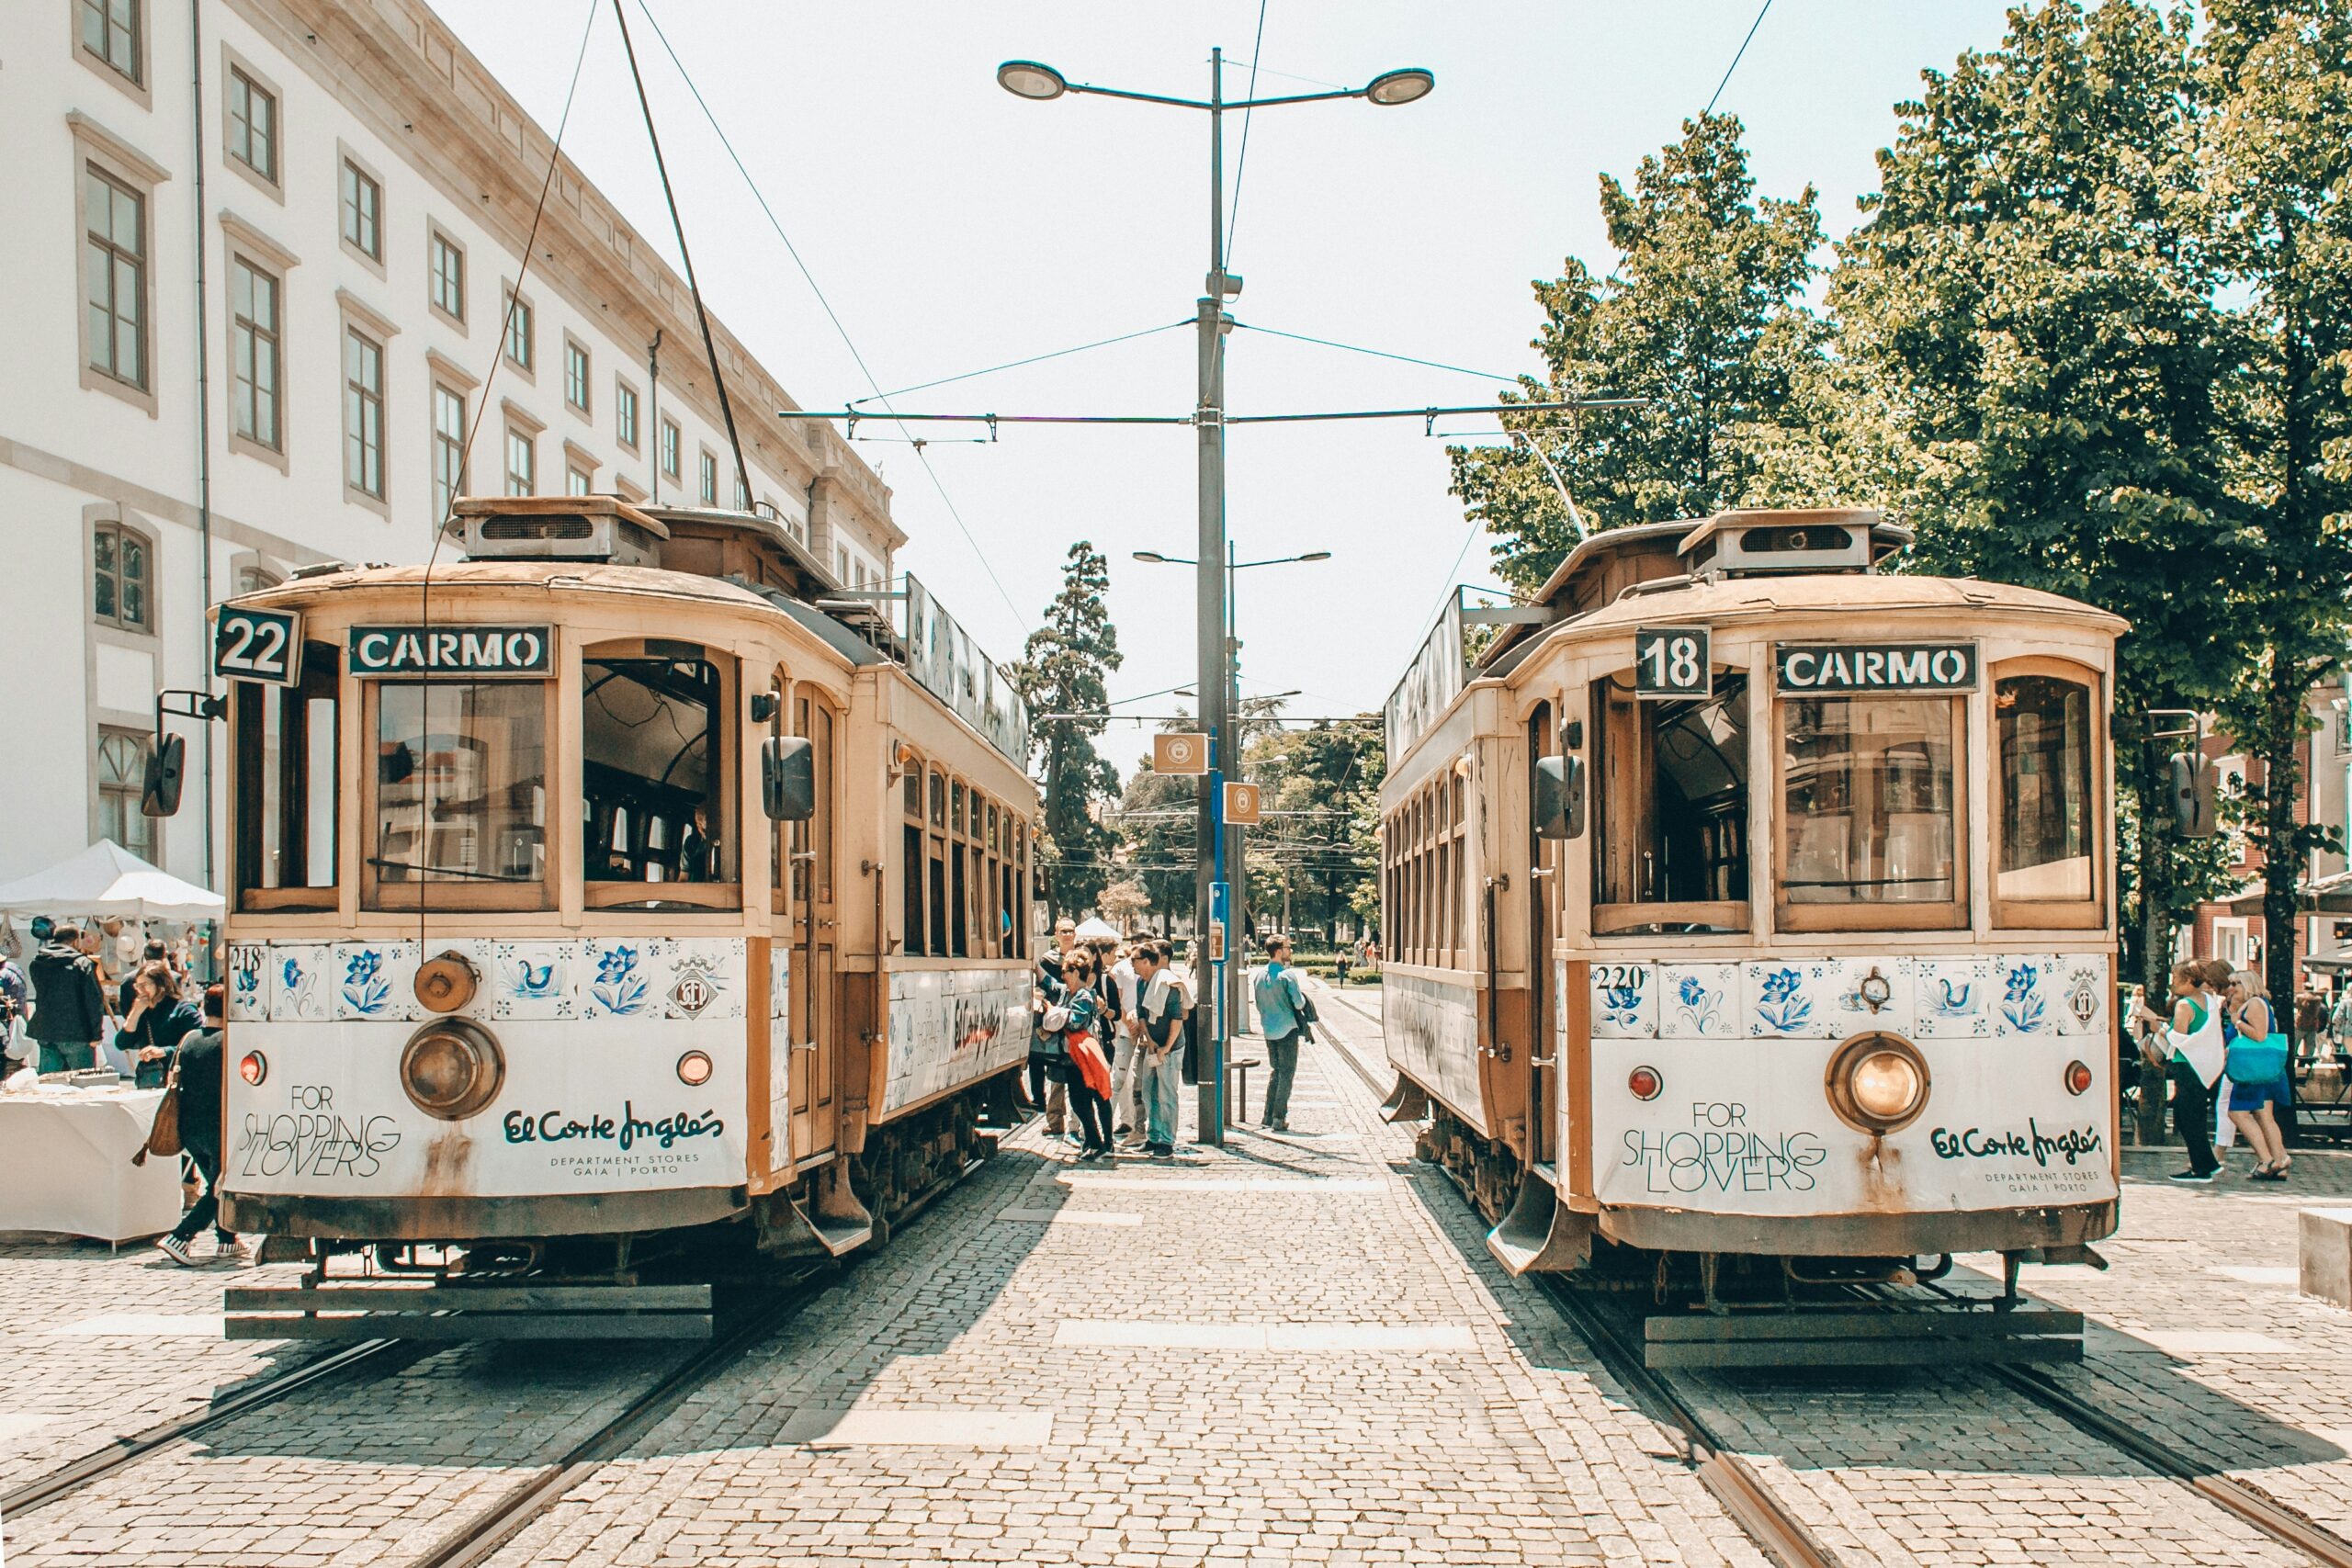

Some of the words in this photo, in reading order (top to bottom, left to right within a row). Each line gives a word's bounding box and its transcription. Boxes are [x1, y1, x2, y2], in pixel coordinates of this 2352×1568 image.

[220, 616, 287, 674] 22
[357, 631, 541, 668] CARMO
[1644, 636, 1700, 687] 18
[1783, 649, 1967, 687] CARMO
[231, 945, 261, 972] 218
[1596, 965, 1645, 989] 220
[291, 1086, 334, 1110] FOR
[1692, 1102, 1746, 1127] FOR
[239, 1112, 401, 1152] SHOPPING
[503, 1110, 537, 1144] El
[538, 1111, 616, 1142] Corte
[1930, 1127, 1964, 1159] El
[1962, 1127, 2030, 1157] Corte
[242, 1140, 380, 1178] LOVERS
[550, 1156, 640, 1167] DEPARTMENT
[649, 1154, 699, 1164] STORES
[1623, 1129, 1826, 1168] SHOPPING
[573, 1167, 608, 1177] GAIA
[630, 1165, 679, 1175] PORTO
[1647, 1155, 1815, 1193] LOVERS
[1985, 1172, 2058, 1182] DEPARTMENT
[2063, 1171, 2099, 1181] STORES
[2009, 1184, 2039, 1192] GAIA
[2054, 1183, 2086, 1192] PORTO
